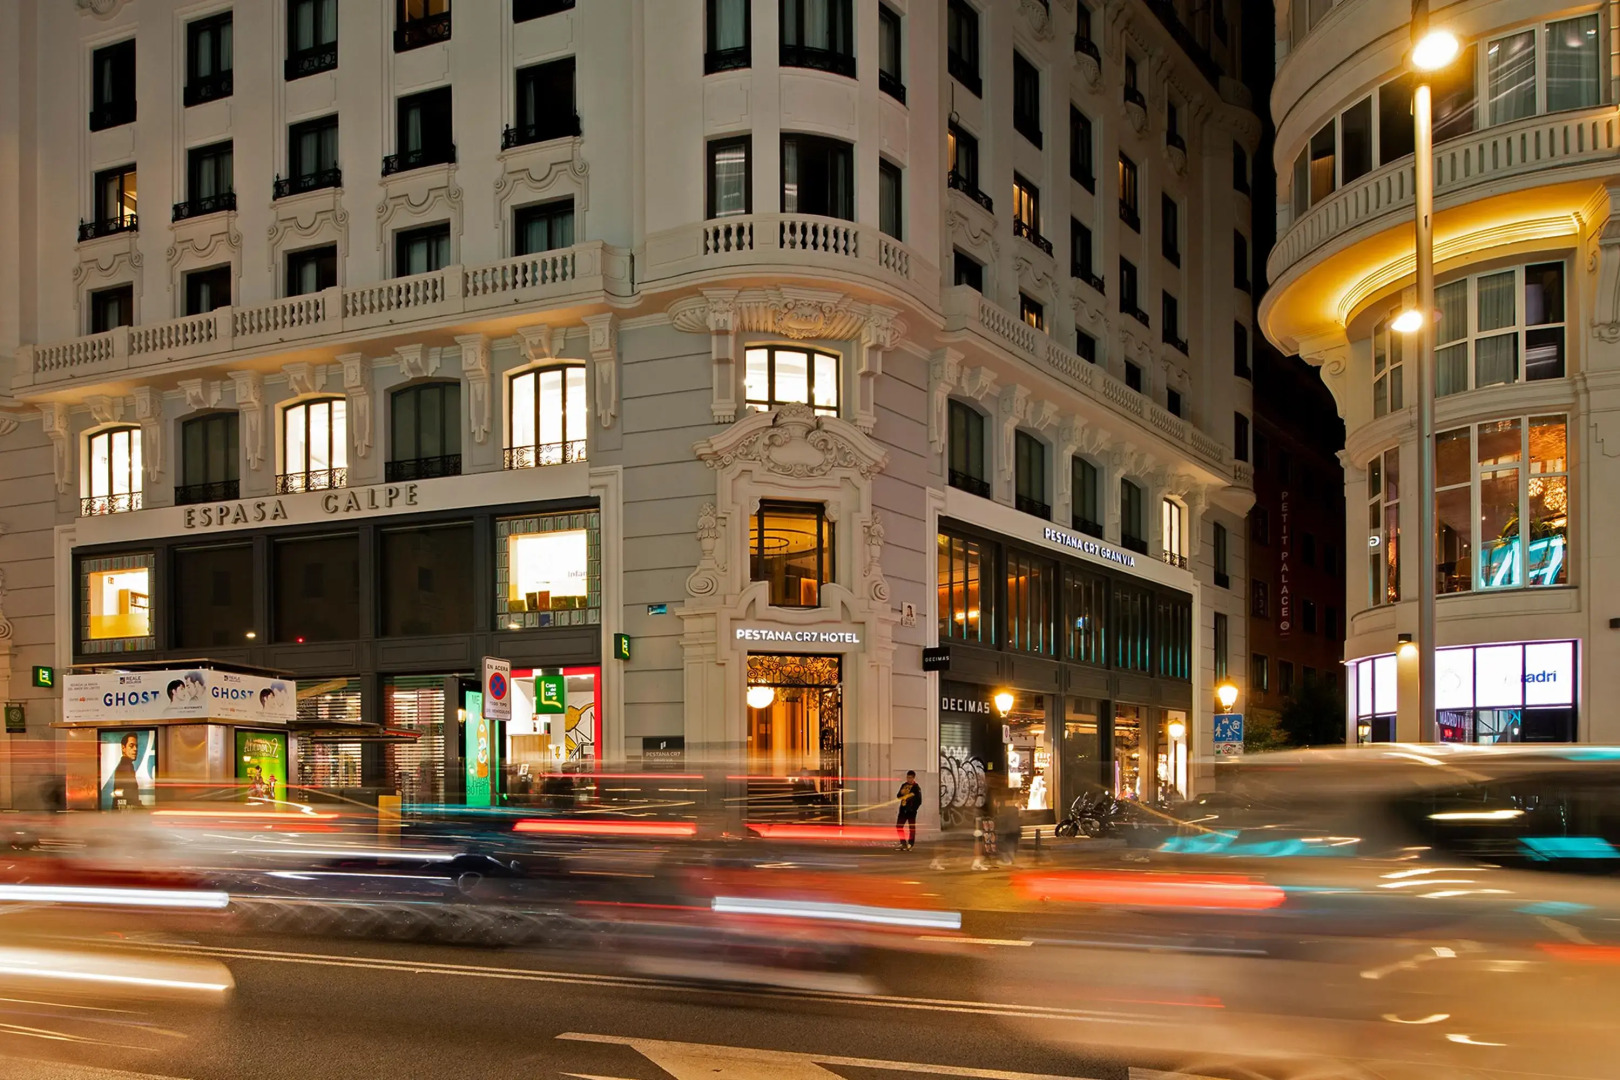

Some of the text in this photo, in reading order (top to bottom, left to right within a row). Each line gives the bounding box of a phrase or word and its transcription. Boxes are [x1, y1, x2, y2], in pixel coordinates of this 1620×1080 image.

[184, 483, 419, 529] ESPASA CALPE
[1043, 527, 1083, 551] PESTANA
[1083, 541, 1099, 556] CR7
[1280, 491, 1289, 617] PETIT PALACE
[736, 629, 860, 643] PESTANA CR7 HOTEL
[924, 655, 950, 663] DECIMAS
[103, 690, 160, 707] GHOST
[211, 686, 254, 700] GHOST
[942, 697, 990, 714] DECIMAS
